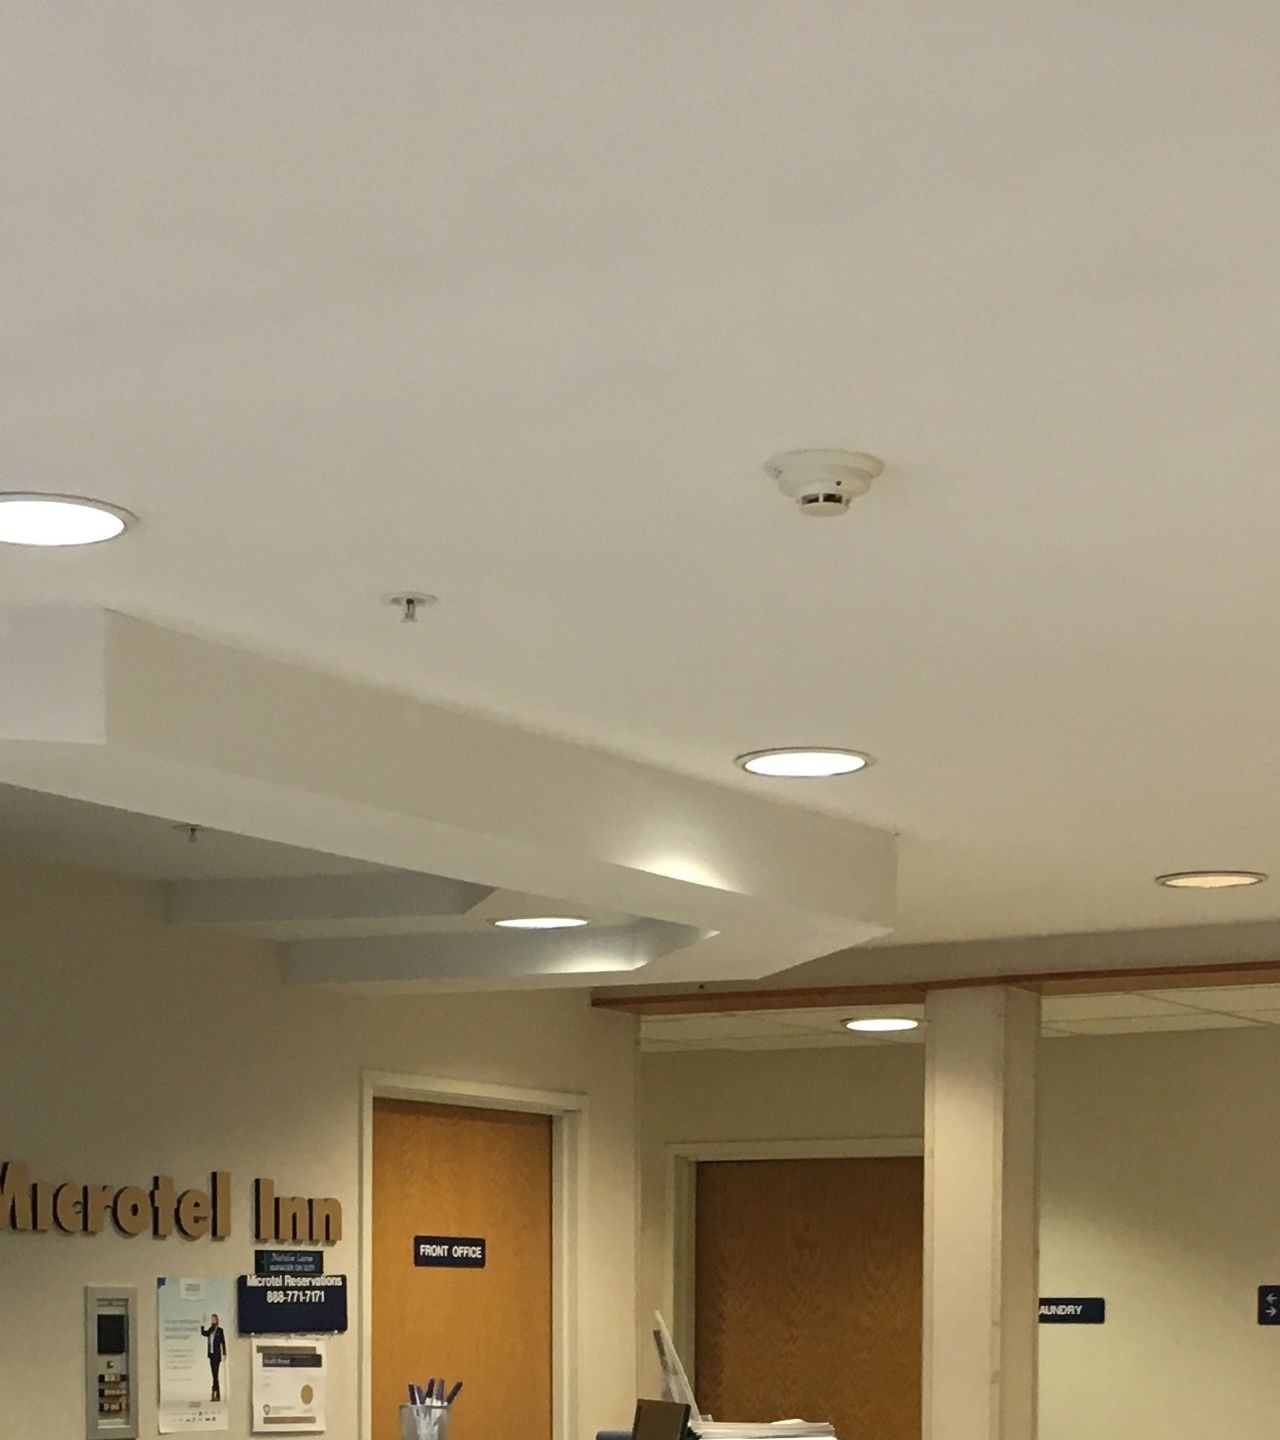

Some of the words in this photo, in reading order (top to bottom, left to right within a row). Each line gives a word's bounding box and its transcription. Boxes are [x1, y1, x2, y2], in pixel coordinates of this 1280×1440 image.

[254, 1177, 342, 1246] Inn
[420, 1244, 449, 1257] FRONT
[452, 1246, 482, 1258] OFFICE
[246, 1275, 282, 1287] Microtel
[284, 1275, 343, 1287] Reservations
[266, 1290, 325, 1303] 888-771-7171
